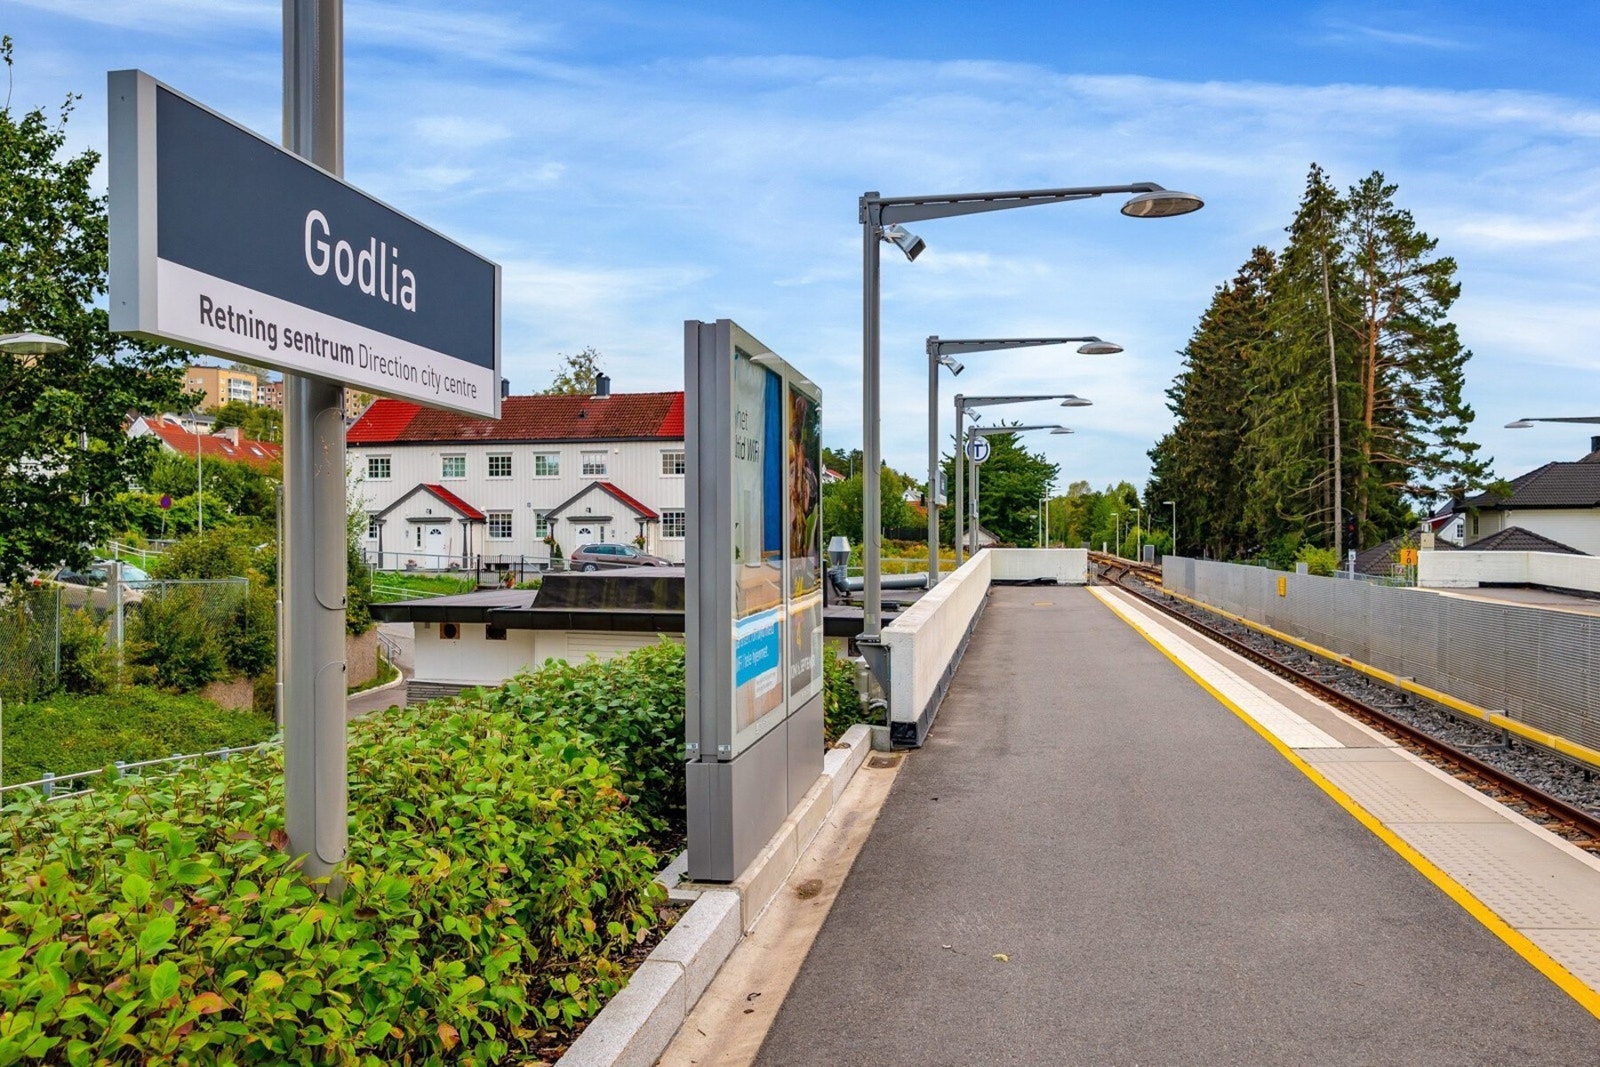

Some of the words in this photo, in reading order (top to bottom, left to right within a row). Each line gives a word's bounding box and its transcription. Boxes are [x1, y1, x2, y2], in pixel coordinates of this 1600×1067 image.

[304, 209, 416, 313] Godlia
[199, 294, 277, 351] Retning
[283, 327, 355, 366] sentrum
[359, 343, 418, 383] Direction
[421, 365, 441, 395] city
[444, 376, 477, 399] centre
[973, 444, 983, 458] T
